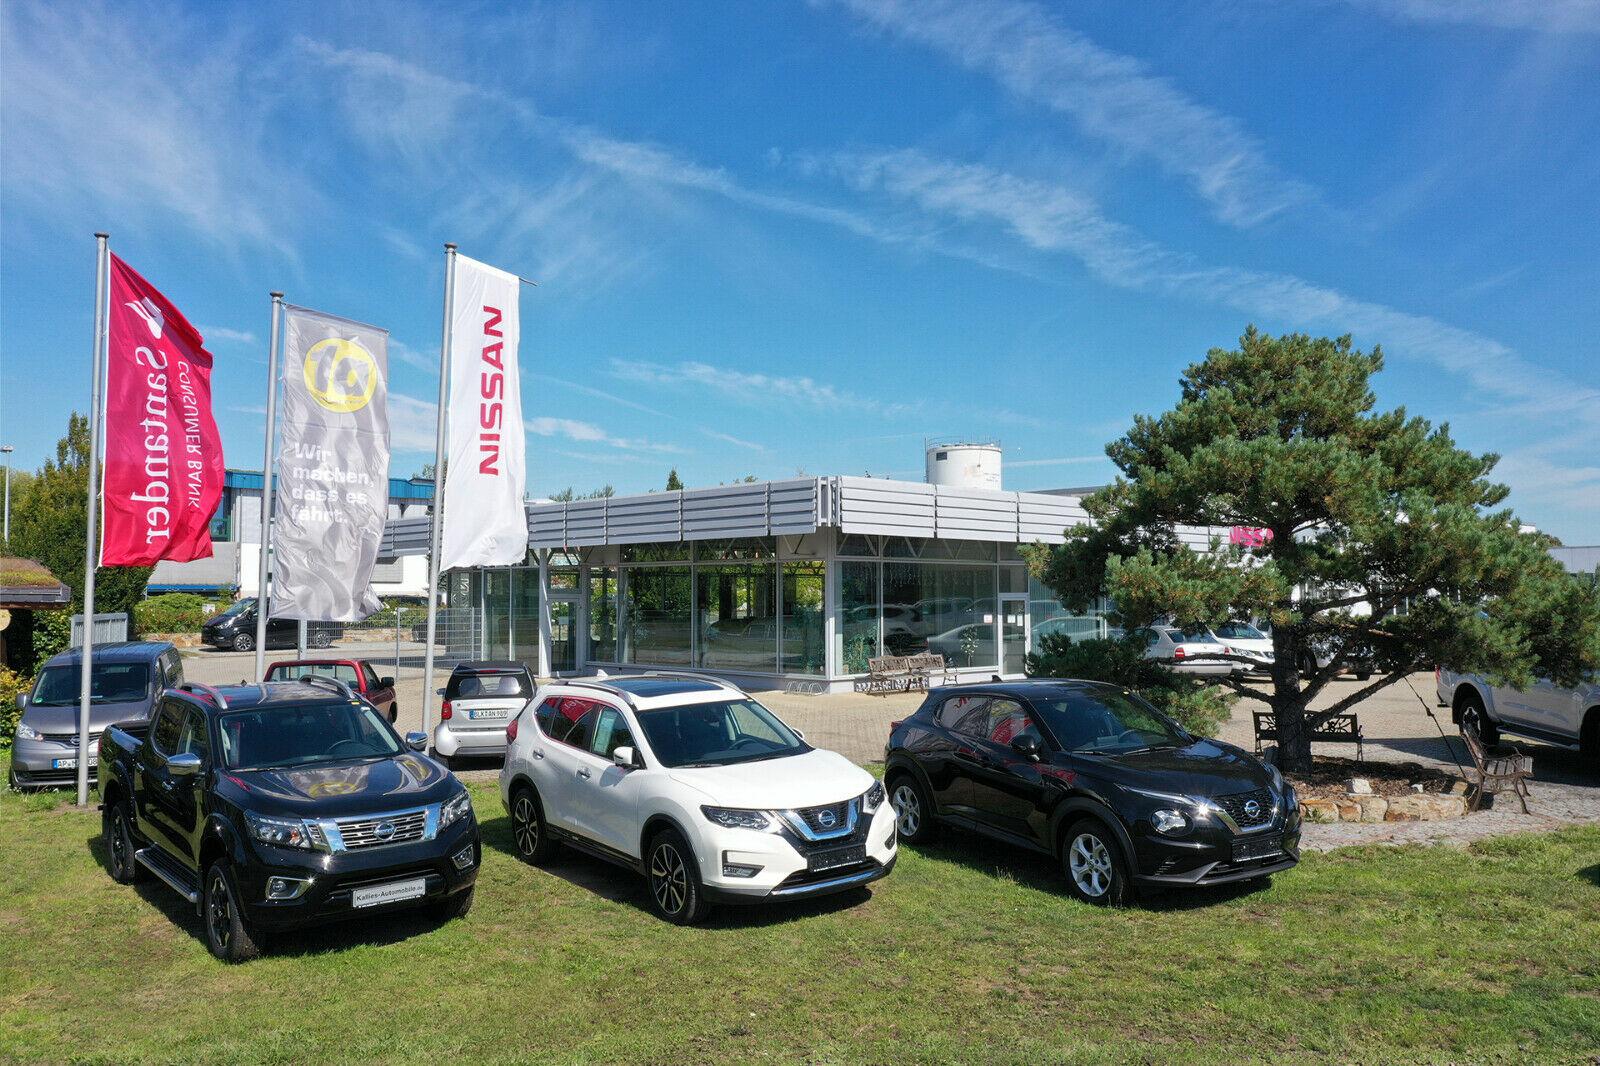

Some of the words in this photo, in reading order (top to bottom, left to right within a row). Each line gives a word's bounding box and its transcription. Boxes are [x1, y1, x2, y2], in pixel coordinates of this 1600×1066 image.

[479, 305, 504, 476] NISSAN
[294, 443, 331, 461] Wir
[292, 466, 374, 487] machen,
[291, 483, 339, 501] dass
[346, 492, 367, 504] es
[57, 760, 67, 768] AP
[356, 886, 423, 901] Kallies-Automobile.de
